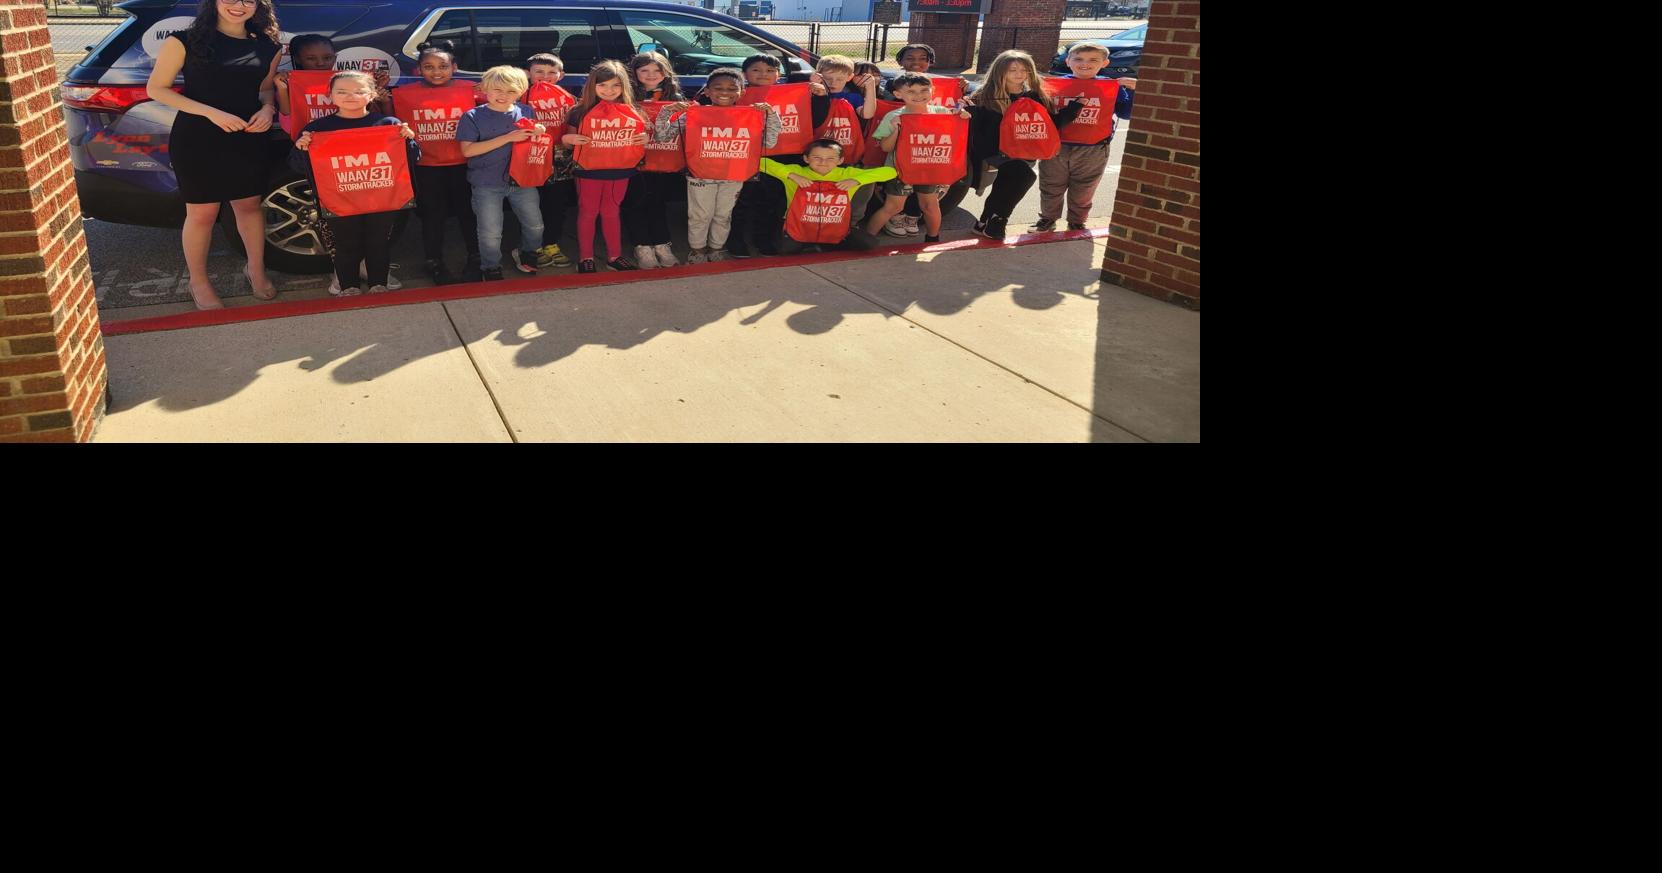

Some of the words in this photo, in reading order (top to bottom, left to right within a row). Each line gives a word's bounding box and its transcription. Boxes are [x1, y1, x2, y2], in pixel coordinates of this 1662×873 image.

[337, 60, 361, 70] WAAY
[362, 59, 380, 71] 31
[413, 109, 446, 120] I'M
[785, 104, 798, 114] A
[1080, 108, 1100, 118] 31
[536, 110, 560, 120] WAAY
[1034, 112, 1044, 121] A
[418, 123, 445, 133] WAAY
[446, 121, 458, 133] 3
[591, 118, 620, 128] I'M
[625, 117, 637, 127] A
[782, 116, 798, 127] 31
[702, 127, 732, 138] I'M
[736, 128, 750, 138] A
[1030, 123, 1046, 133] 31
[592, 130, 617, 140] WAAY
[617, 129, 635, 140] 31
[910, 134, 935, 144] I'M
[939, 135, 952, 144] A
[703, 141, 730, 151] WAAY
[729, 140, 750, 152] 31
[912, 147, 933, 156] WAAY
[933, 146, 951, 157] 31
[331, 153, 369, 169] I'M
[375, 152, 391, 165] A
[702, 151, 748, 159] STORMTRACKER
[337, 170, 369, 183] WAAY
[369, 166, 392, 181] 31
[338, 179, 394, 192] STORMTRACKER
[806, 191, 834, 203] I'M
[835, 195, 848, 204] A
[805, 205, 828, 216] WAAY
[828, 206, 846, 217] 31
